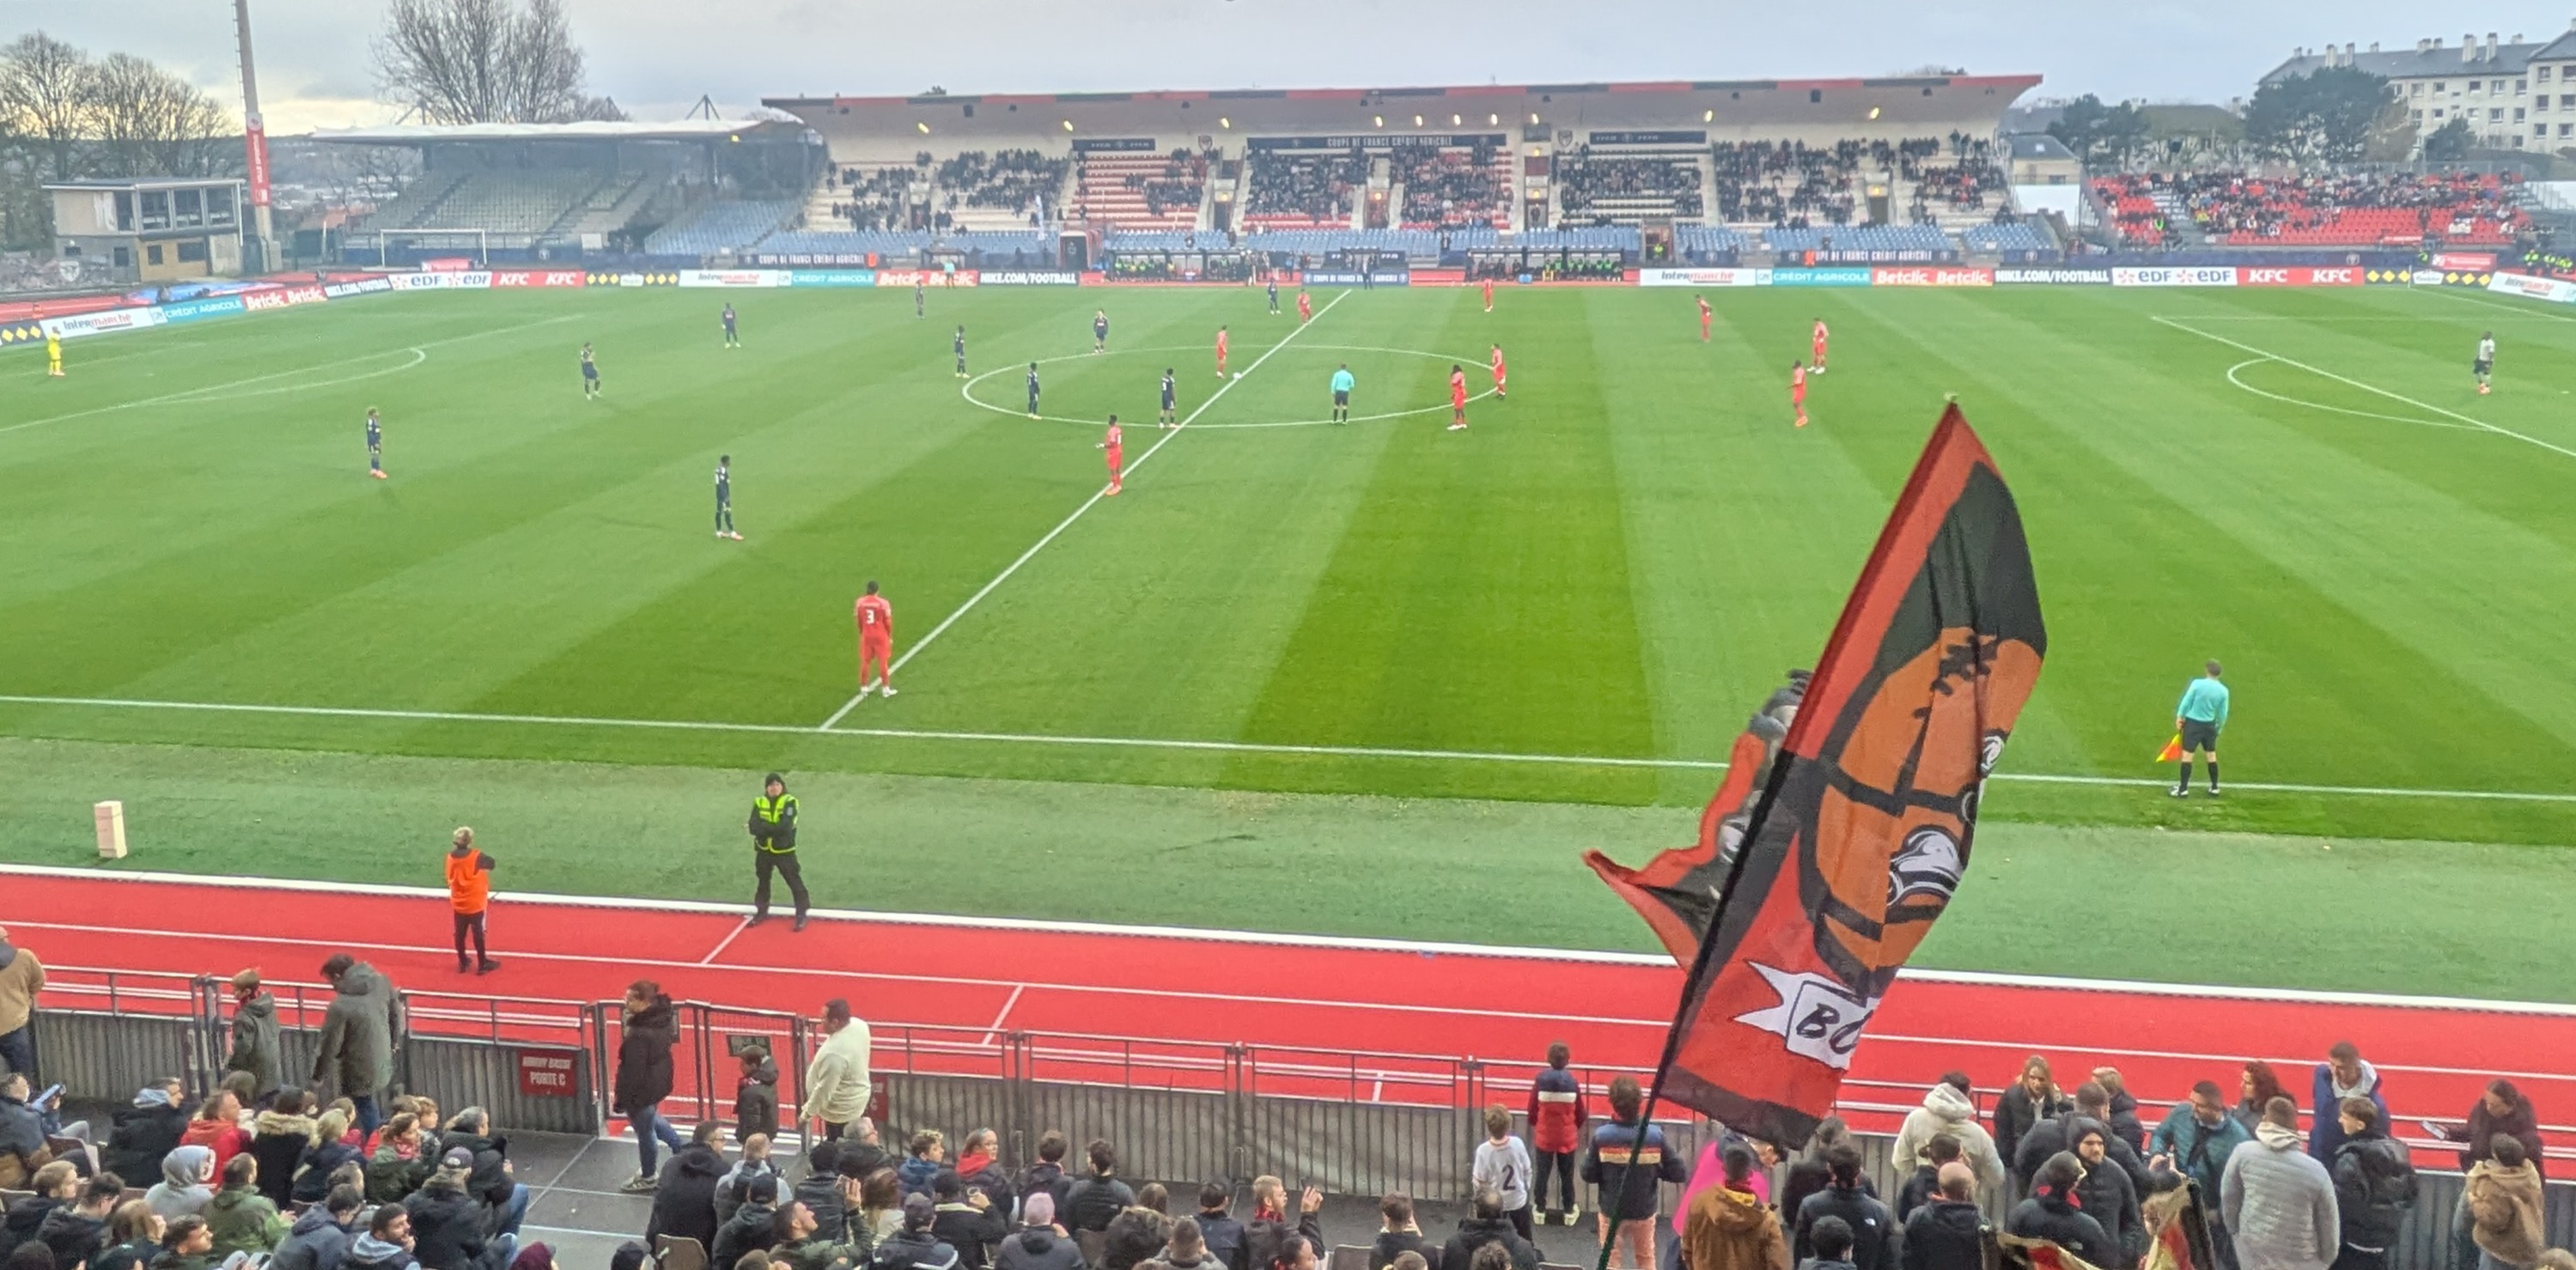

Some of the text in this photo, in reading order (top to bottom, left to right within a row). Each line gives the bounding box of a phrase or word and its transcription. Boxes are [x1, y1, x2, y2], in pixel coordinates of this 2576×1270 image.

[499, 273, 530, 286] KFC
[545, 273, 576, 286] KFC
[828, 274, 874, 283] AGRICOLE
[880, 272, 924, 285] Betclic
[929, 272, 973, 285] Beclic
[980, 272, 1076, 284] NIKE.COM/FOOTBALL
[1774, 270, 1869, 282] CRÉDIT AGRICOLE
[1876, 271, 1927, 284] Betclic
[1936, 271, 1988, 284] Betclic
[1995, 270, 2110, 283] NIKE.COM/FOOTBALL
[2249, 270, 2287, 283] KFC
[2312, 270, 2352, 283] KFC
[288, 284, 323, 304] Betclic
[200, 301, 243, 313] AGRICOLE
[247, 293, 285, 311] Betclic
[866, 609, 874, 625] 3
[1501, 1164, 1516, 1191] 2
